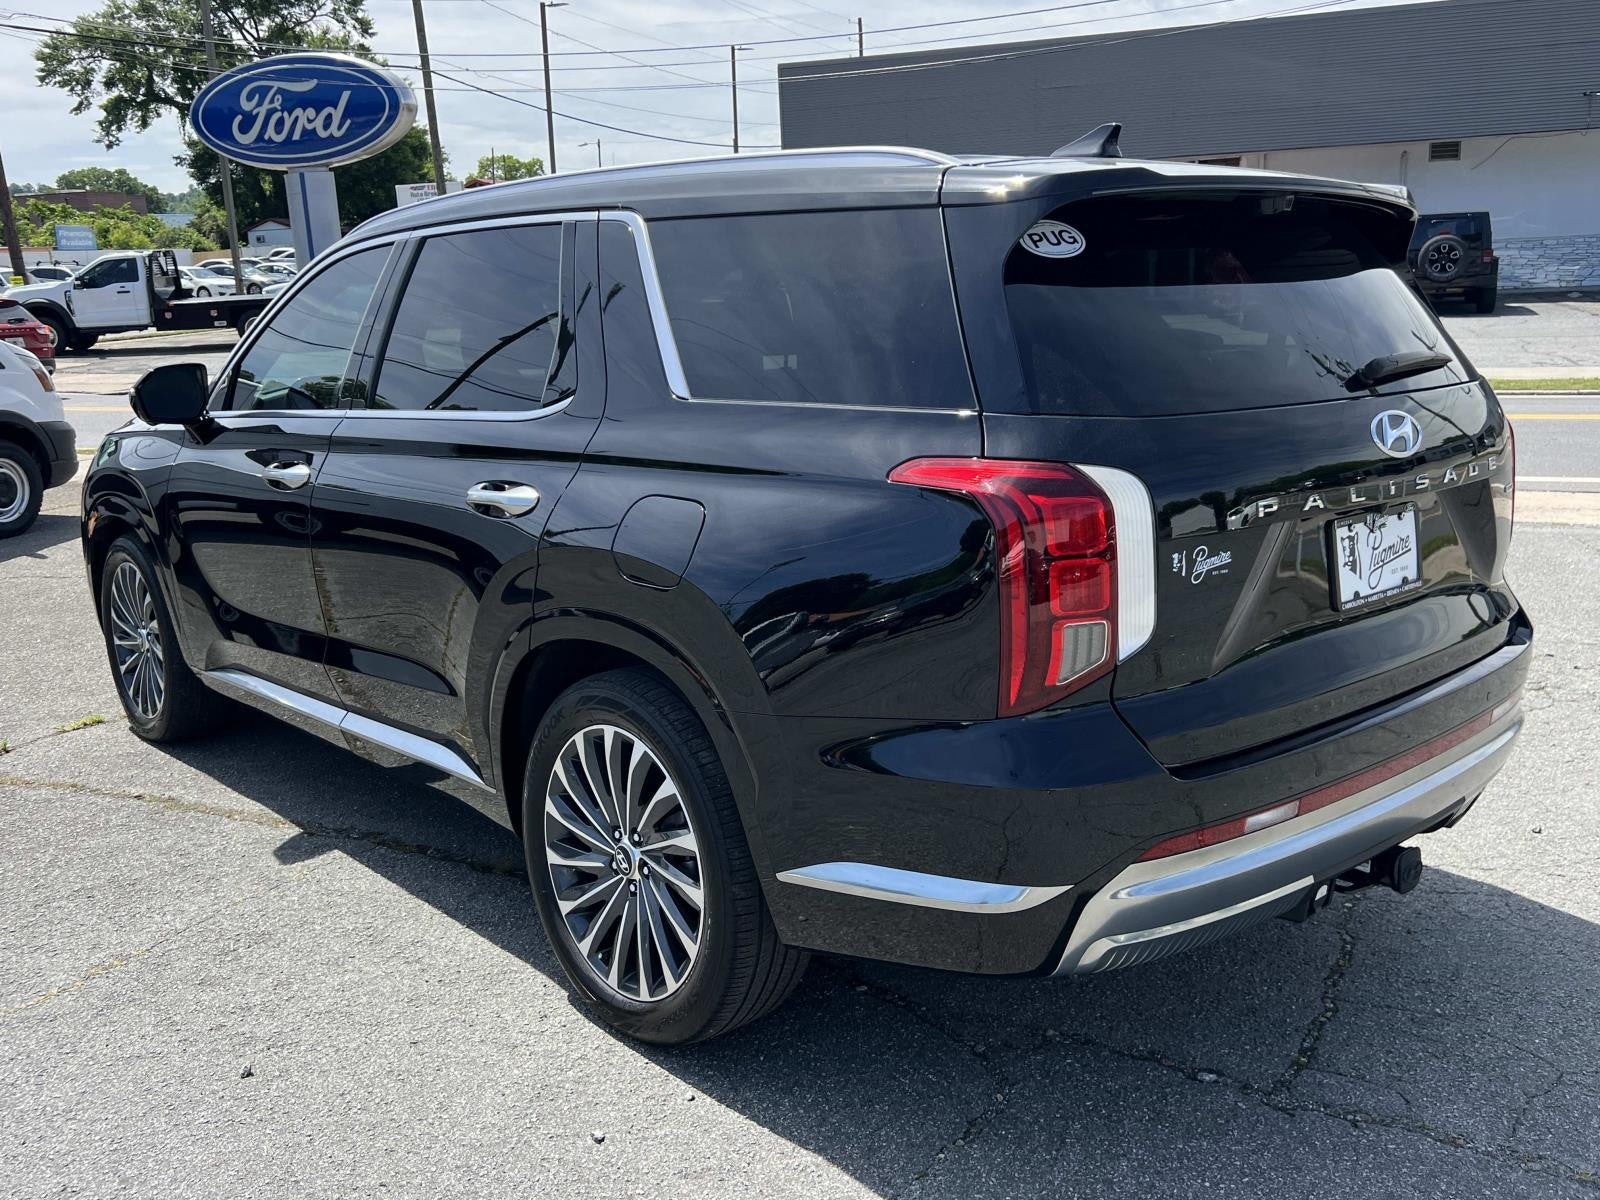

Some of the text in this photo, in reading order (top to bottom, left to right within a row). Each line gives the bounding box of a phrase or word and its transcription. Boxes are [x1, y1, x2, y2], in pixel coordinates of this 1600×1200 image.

[231, 78, 352, 145] Ford
[1026, 229, 1080, 249] PUG
[1256, 456, 1497, 518] PALISADE
[1191, 545, 1232, 584] Pugmire
[1367, 527, 1412, 590] Pugmire
